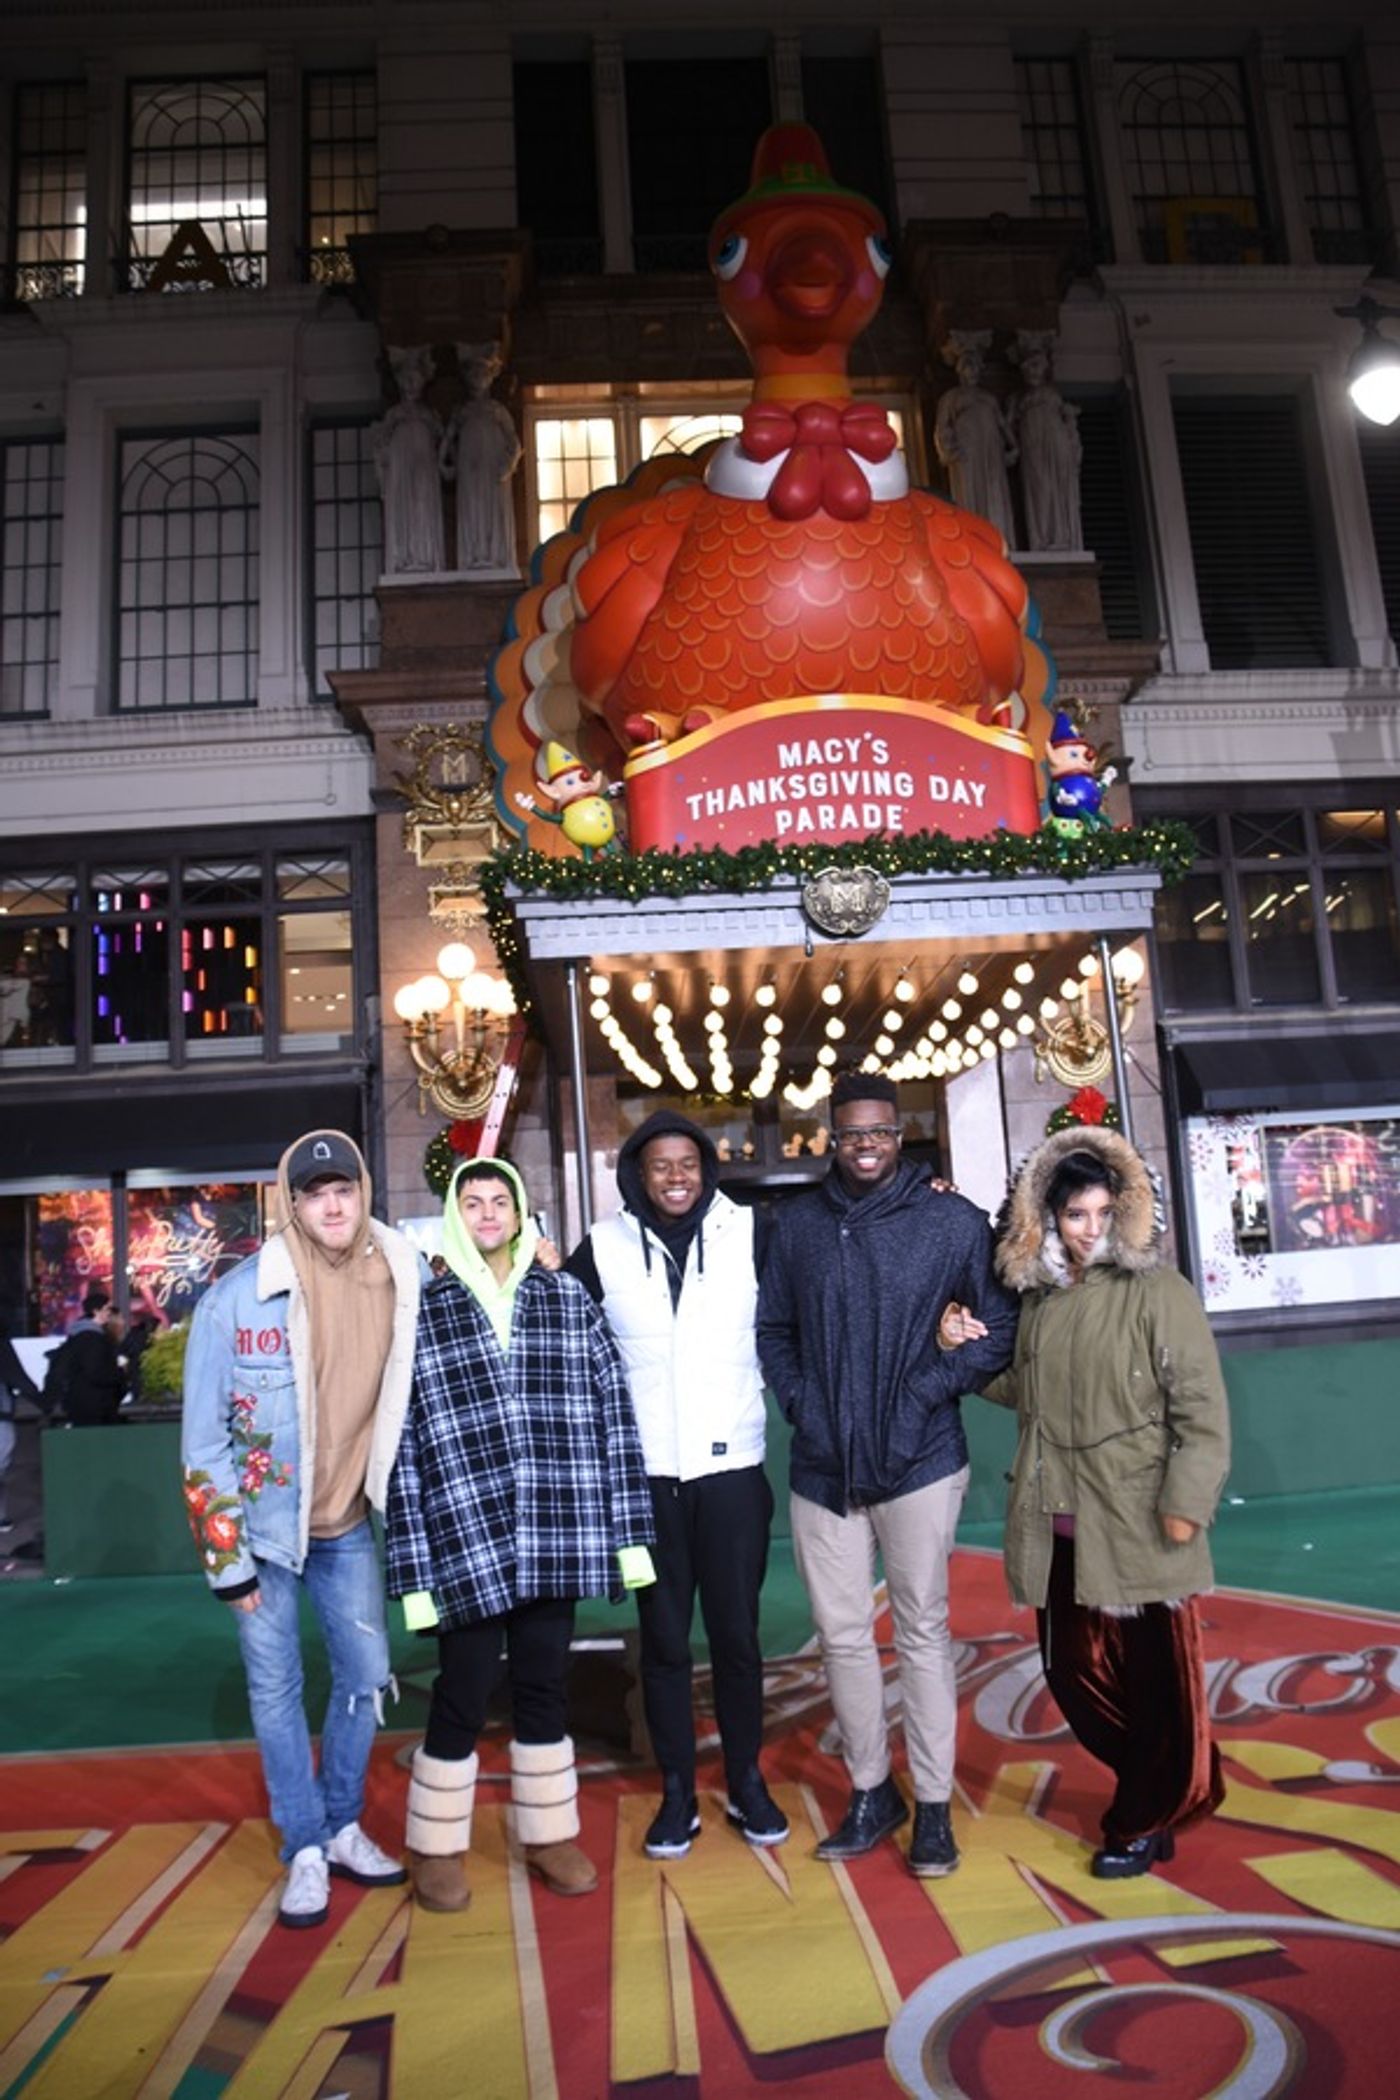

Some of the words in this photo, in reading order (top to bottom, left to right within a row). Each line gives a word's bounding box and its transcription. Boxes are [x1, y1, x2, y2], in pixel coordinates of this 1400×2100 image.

[777, 731, 889, 769] MACY'S
[684, 769, 915, 821] THANKSGIVING
[928, 774, 987, 810] DAY
[773, 802, 905, 837] PARADE
